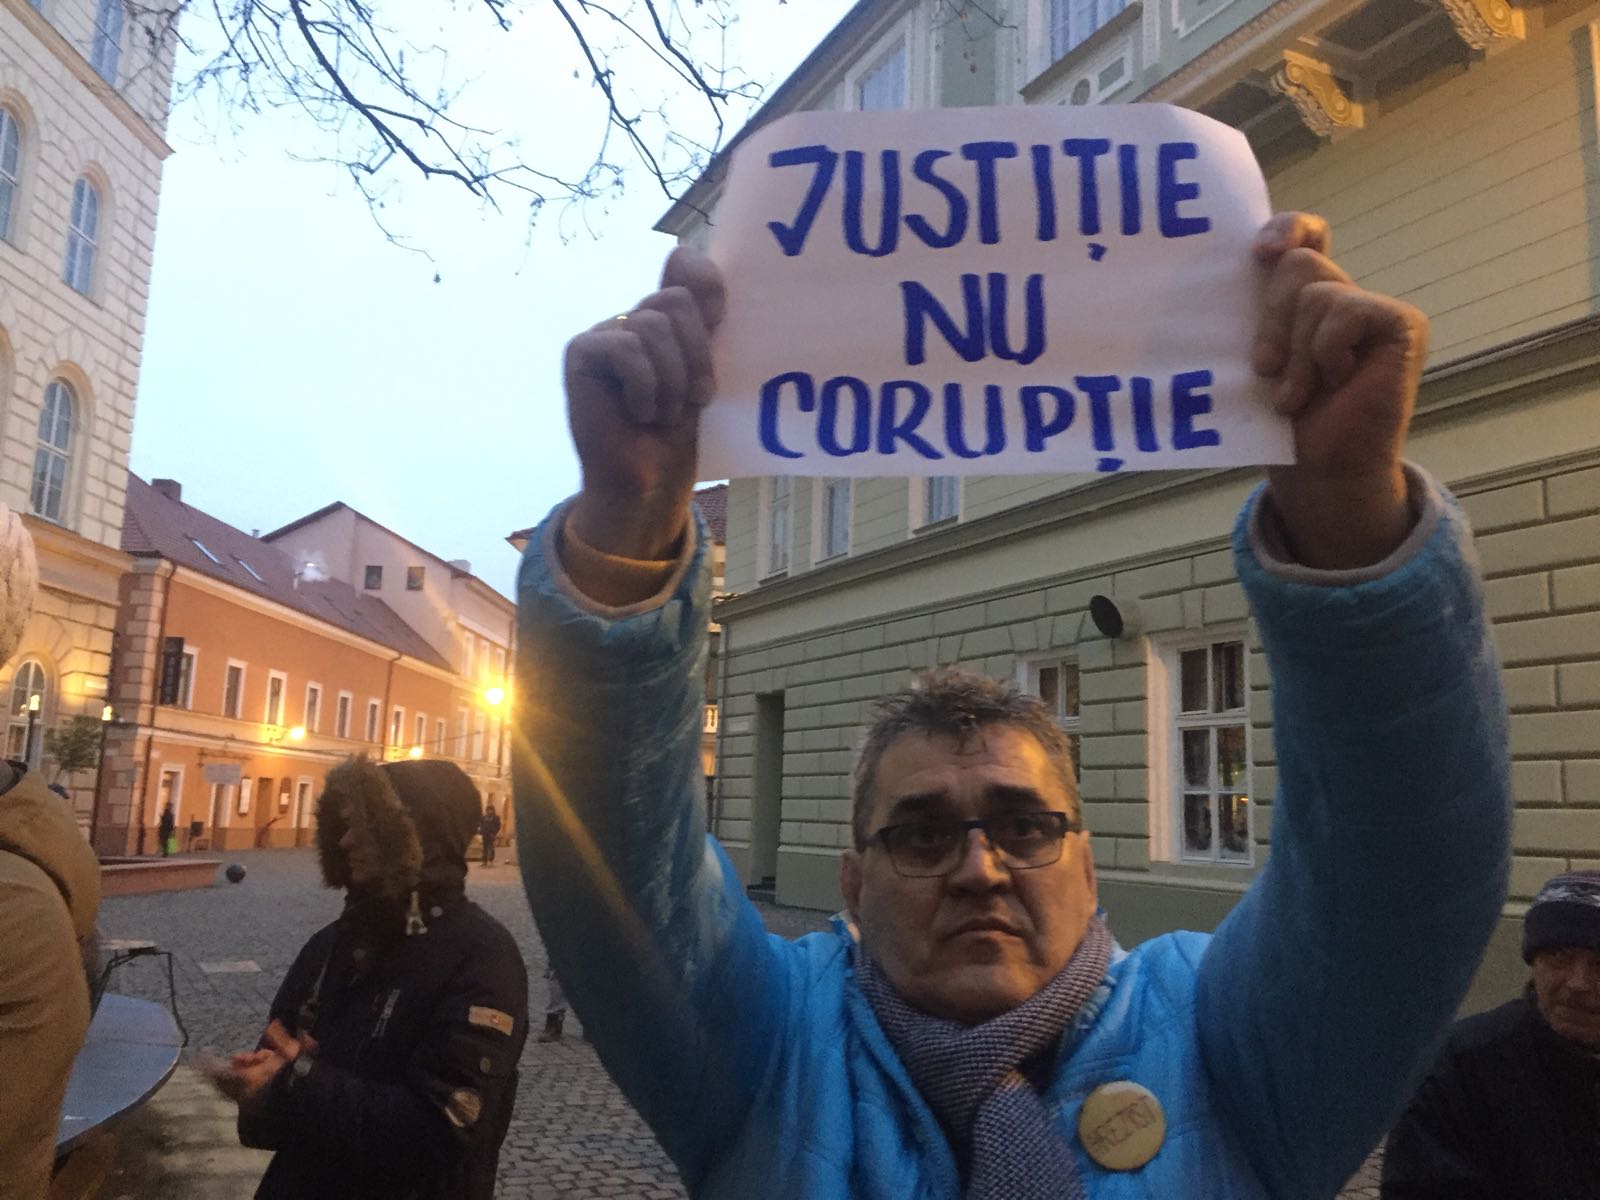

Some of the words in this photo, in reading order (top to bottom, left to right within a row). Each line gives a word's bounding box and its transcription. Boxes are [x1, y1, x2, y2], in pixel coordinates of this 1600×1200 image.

[767, 138, 1211, 260] JUSTIȚIE
[902, 273, 1046, 364] NU
[757, 370, 1221, 473] CORUPȚIE
